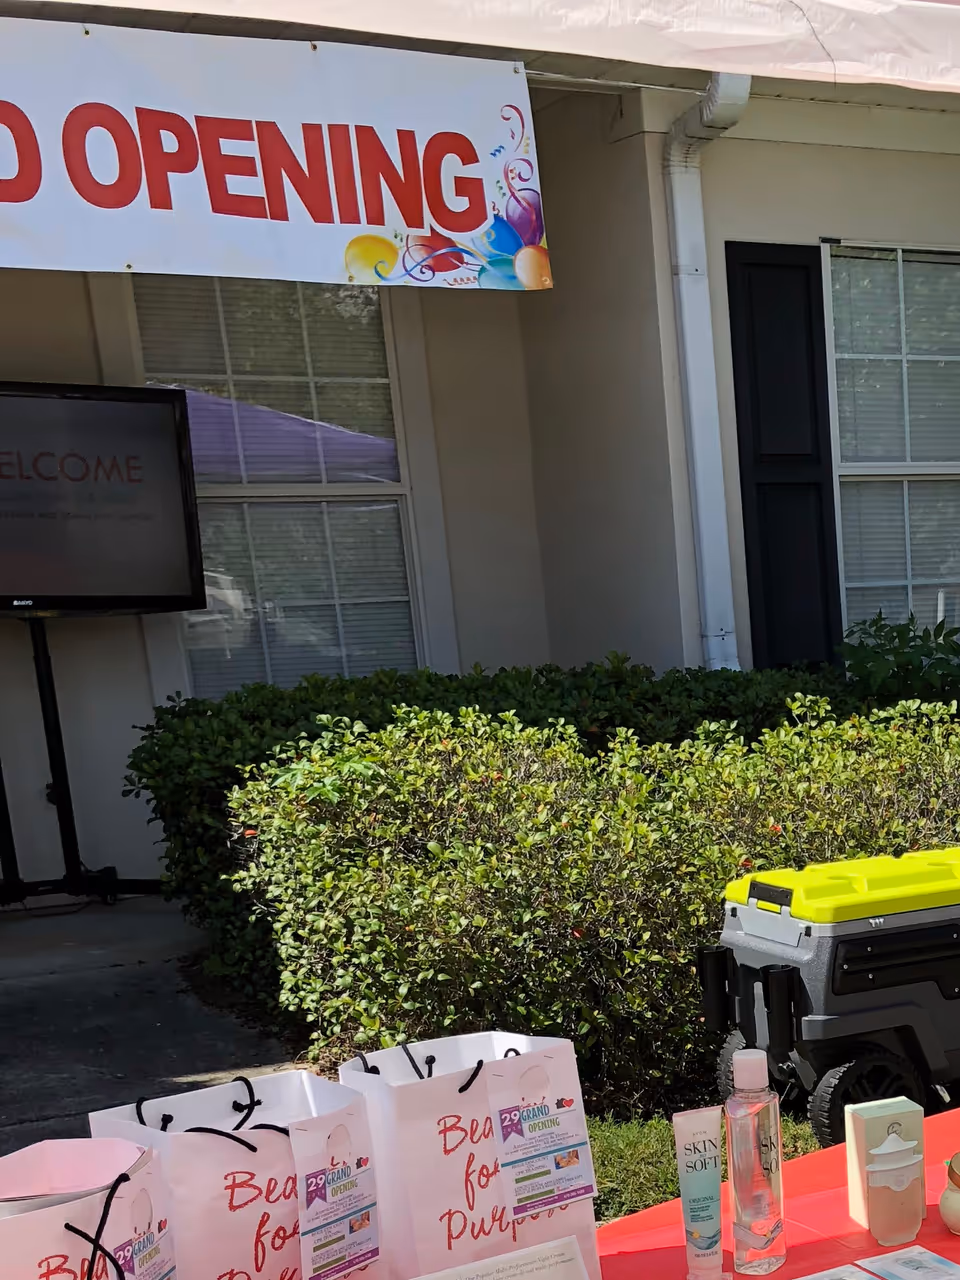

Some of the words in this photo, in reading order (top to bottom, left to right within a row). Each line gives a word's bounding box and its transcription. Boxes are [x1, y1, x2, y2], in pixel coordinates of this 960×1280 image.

[62, 102, 489, 233] OPENING
[501, 1110, 521, 1127] 29
[521, 1104, 550, 1121] GRAND
[528, 1117, 561, 1134] OPENING
[683, 1137, 719, 1157] SKIN
[685, 1155, 720, 1174] SOFT
[307, 1174, 326, 1192] 29
[326, 1165, 352, 1185] GRAND
[331, 1178, 359, 1198] OPENING
[133, 1231, 155, 1256] GRAND
[116, 1245, 133, 1265] 29
